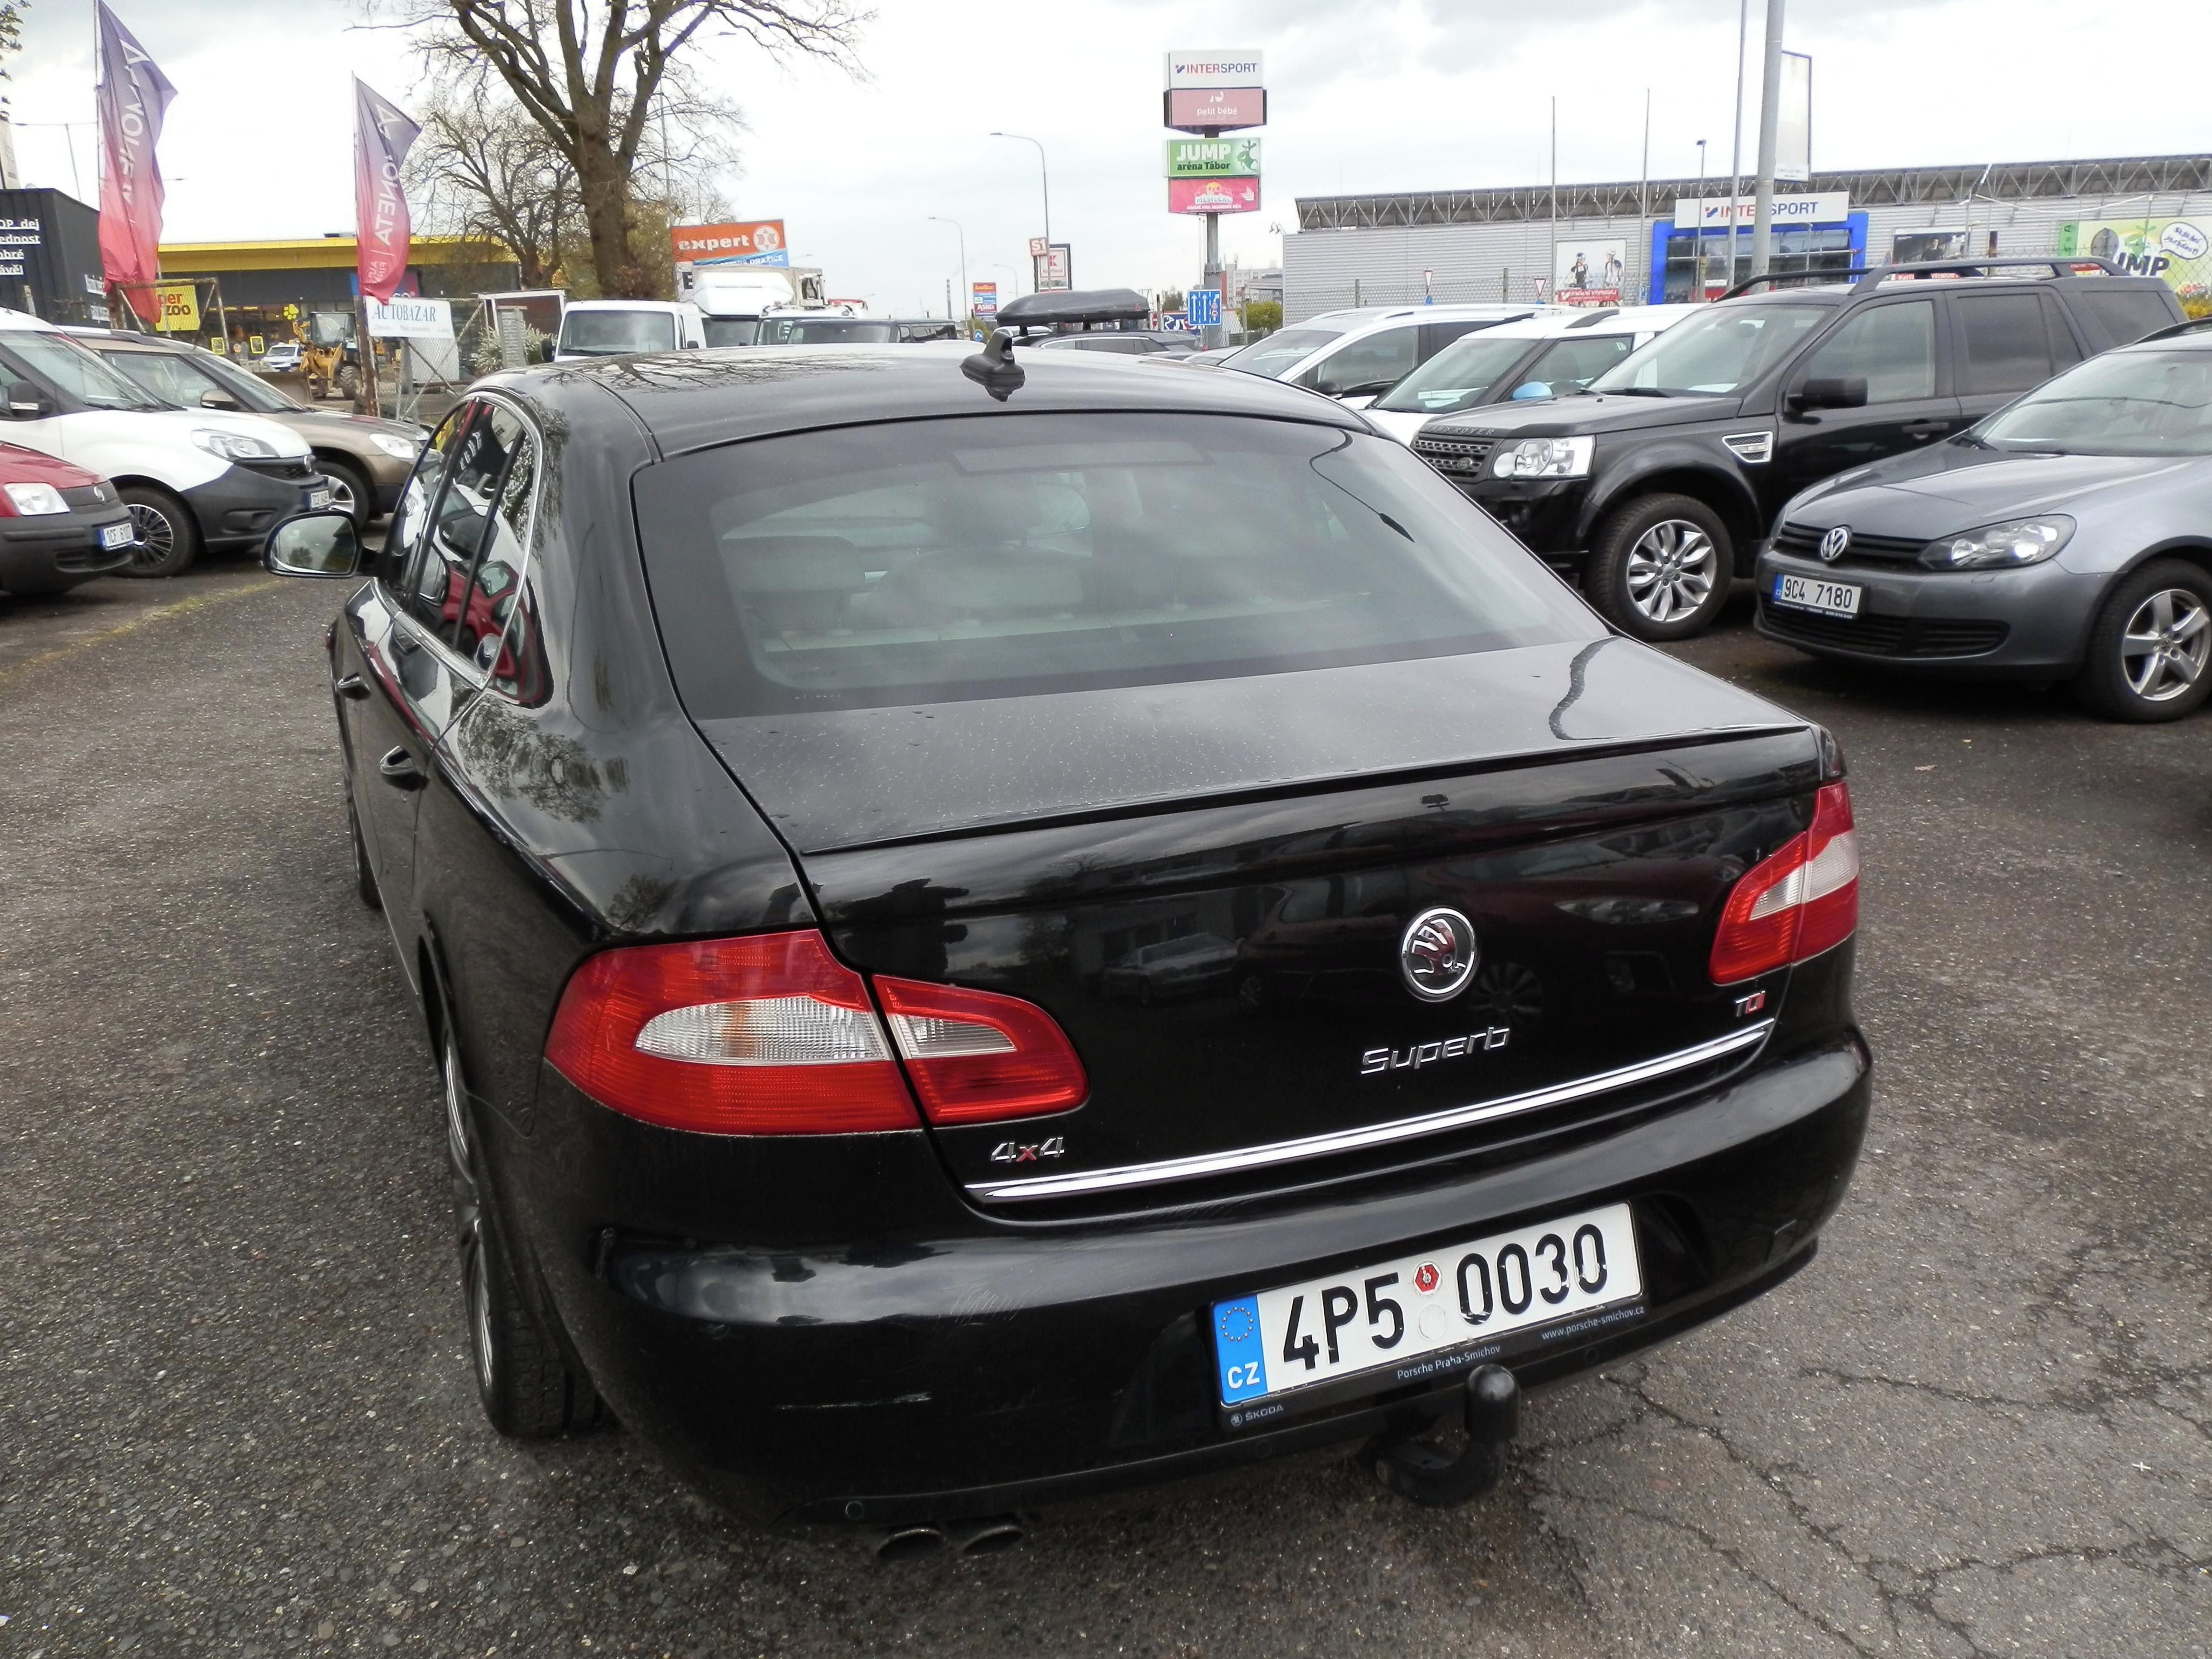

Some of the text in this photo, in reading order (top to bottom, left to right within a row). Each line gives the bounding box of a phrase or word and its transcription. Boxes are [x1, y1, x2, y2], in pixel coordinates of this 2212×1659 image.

[1186, 63, 1257, 73] INTERSPORT
[1197, 106, 1238, 116] petit bébé
[1176, 144, 1231, 161] JUMP
[1177, 160, 1230, 170] aréna Tábor
[1721, 201, 1819, 218] INTESPORT
[21, 219, 39, 231] dej
[678, 234, 750, 251] expert
[1031, 238, 1047, 251] S1
[372, 304, 436, 322] AUTOBAZAR
[1454, 427, 1495, 435] ROVER
[1784, 578, 1853, 609] 9C4 7180
[1360, 1027, 1510, 1075] Superb
[990, 1136, 1065, 1163] 4x4
[1283, 1223, 1609, 1371] 4P5 0030
[1541, 1305, 1645, 1340] www.porsche-smichov.cz
[1227, 1360, 1260, 1390] CZ
[1397, 1363, 1433, 1380] Porsche
[1245, 1404, 1284, 1421] ŠKODA
